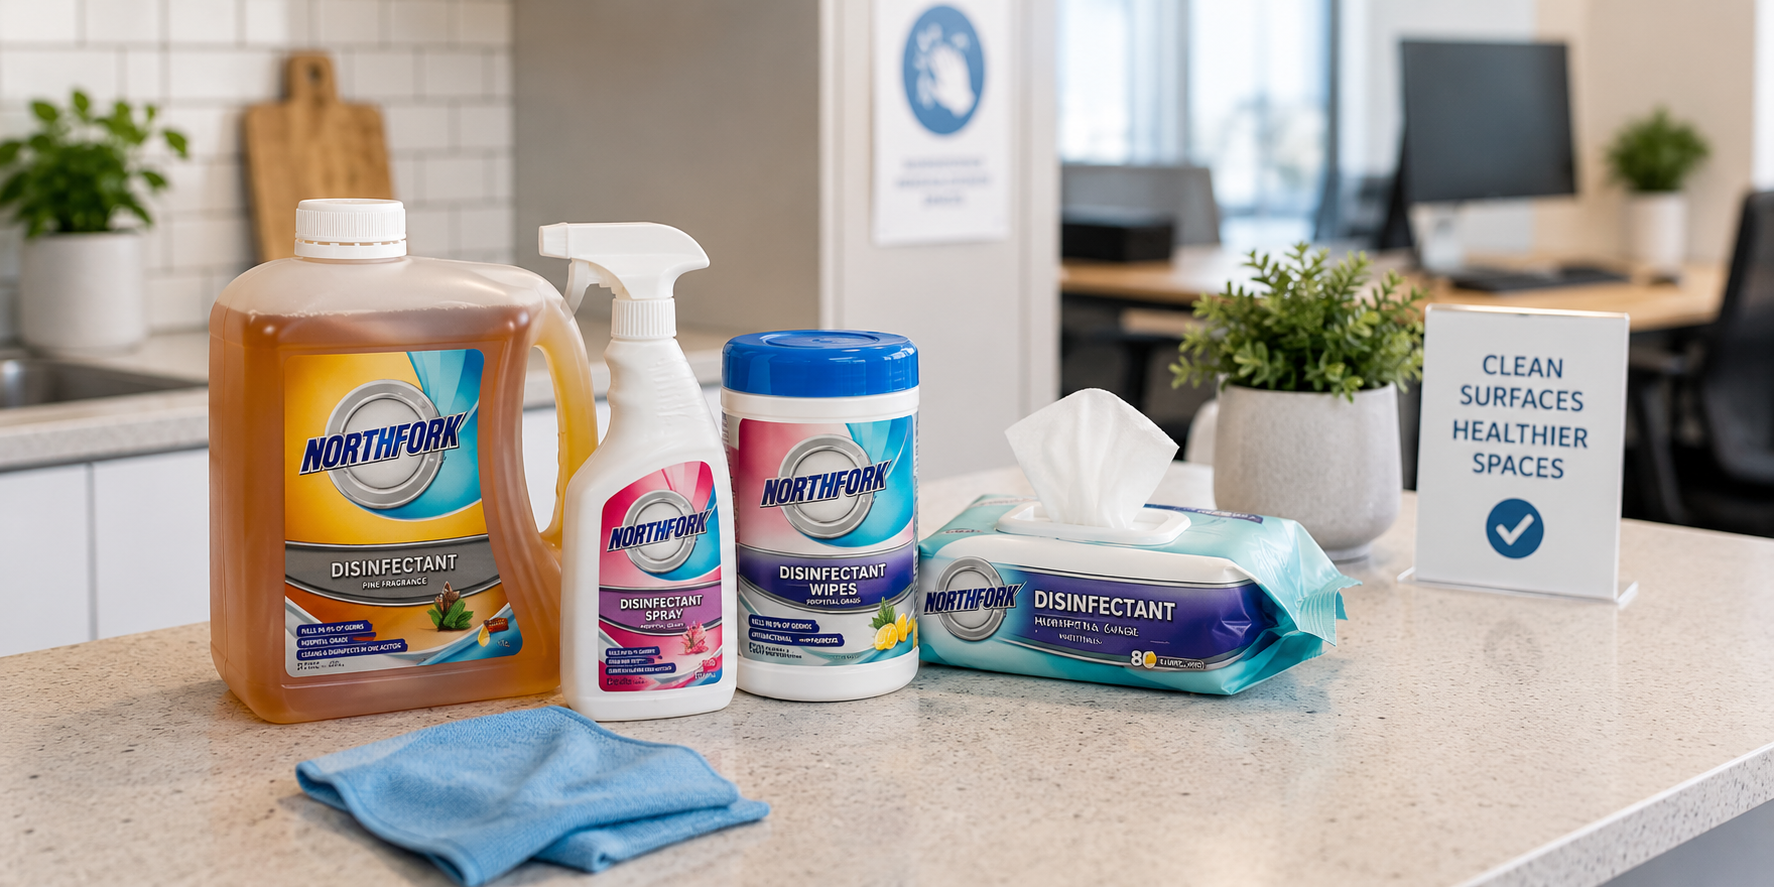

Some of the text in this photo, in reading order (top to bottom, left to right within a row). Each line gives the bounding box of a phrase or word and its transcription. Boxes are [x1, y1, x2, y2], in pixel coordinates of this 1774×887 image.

[1483, 355, 1563, 378] CLEAN
[1460, 385, 1584, 412] SURFACES
[299, 411, 467, 475] NORTHFORK
[1453, 419, 1588, 449] HEALTHIER
[1473, 453, 1564, 479] SPACES
[760, 459, 892, 508] NORTHFORK
[607, 509, 712, 552] NORTHFORK
[331, 554, 458, 578] DISINFECTANT
[779, 563, 887, 581] DISINFECTANT
[362, 577, 428, 589] PINE FRAGRANCE
[809, 583, 858, 596] WIPES
[620, 595, 703, 610] DISINFECTANT
[924, 582, 1025, 615] NORTHFORK
[1034, 590, 1176, 621] DISINFECTANT
[645, 609, 683, 621] SPRAY
